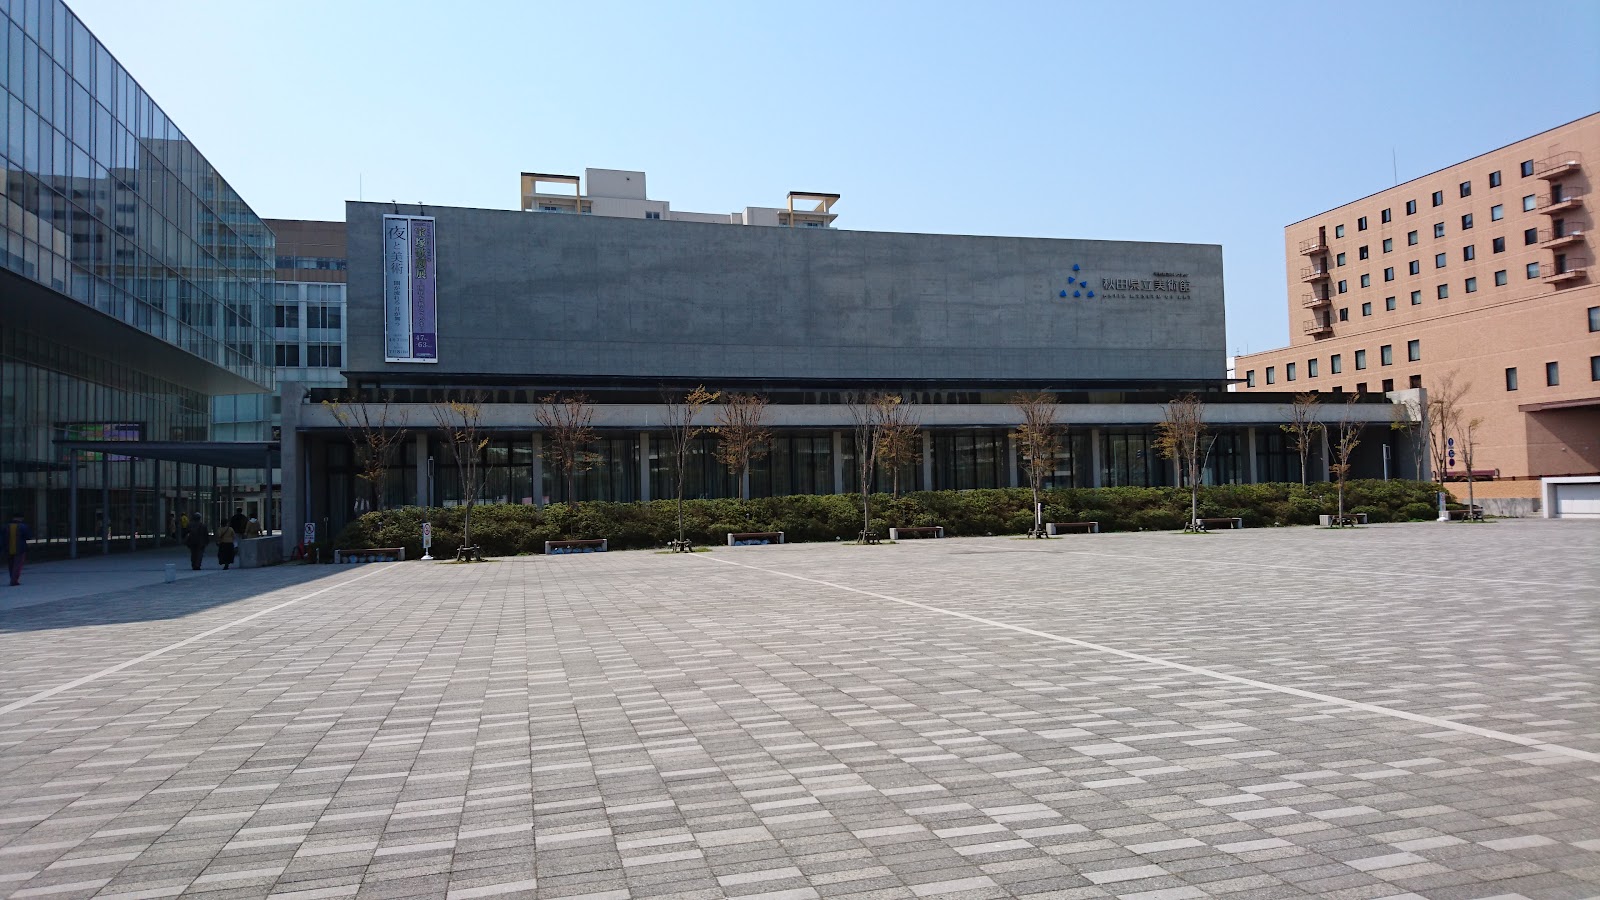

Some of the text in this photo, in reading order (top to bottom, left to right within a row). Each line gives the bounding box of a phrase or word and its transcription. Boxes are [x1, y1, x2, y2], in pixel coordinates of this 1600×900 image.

[388, 226, 405, 274] 夜と美術
[1102, 278, 1190, 292] 秋田県立美術館
